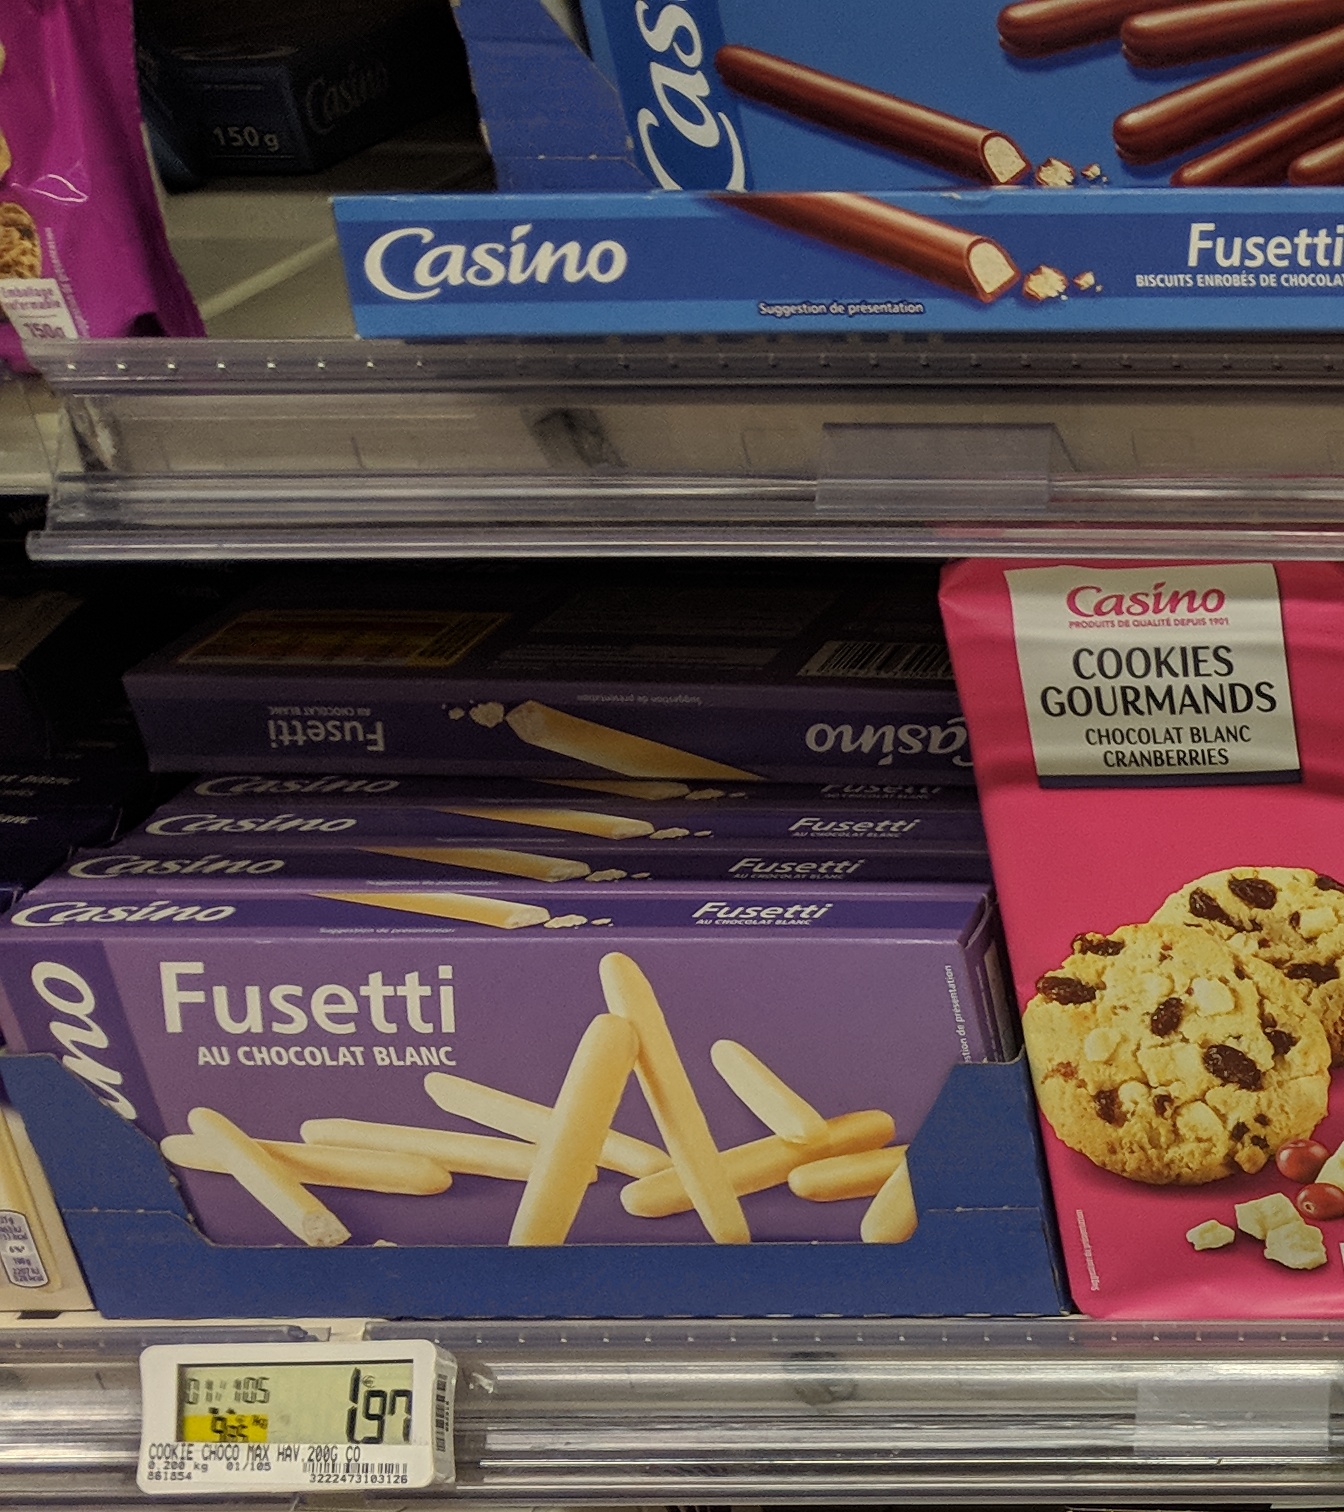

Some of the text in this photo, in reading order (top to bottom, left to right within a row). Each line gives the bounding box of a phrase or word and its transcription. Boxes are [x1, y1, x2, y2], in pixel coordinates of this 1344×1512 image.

[363, 225, 629, 301] Casino
[1135, 274, 1193, 288] BISCUITS
[1197, 271, 1256, 288] ENROBÉS
[1260, 273, 1277, 287] DE
[1071, 646, 1234, 679] COOKIES
[1040, 681, 1278, 718] GOURMANDS
[1084, 725, 1251, 745] CHOCOLAT BLANC
[1103, 748, 1230, 769] CRANBERRIES
[145, 812, 358, 838] Casino
[67, 852, 285, 881] Casino
[11, 898, 237, 929] Casino
[691, 901, 834, 920] Fusetti
[159, 962, 458, 1034] Fusetti
[197, 1044, 456, 1067] AU CHOCOLAT BLANC
[194, 1462, 208, 1472] kg
[310, 1474, 408, 1484] 3222473103126
